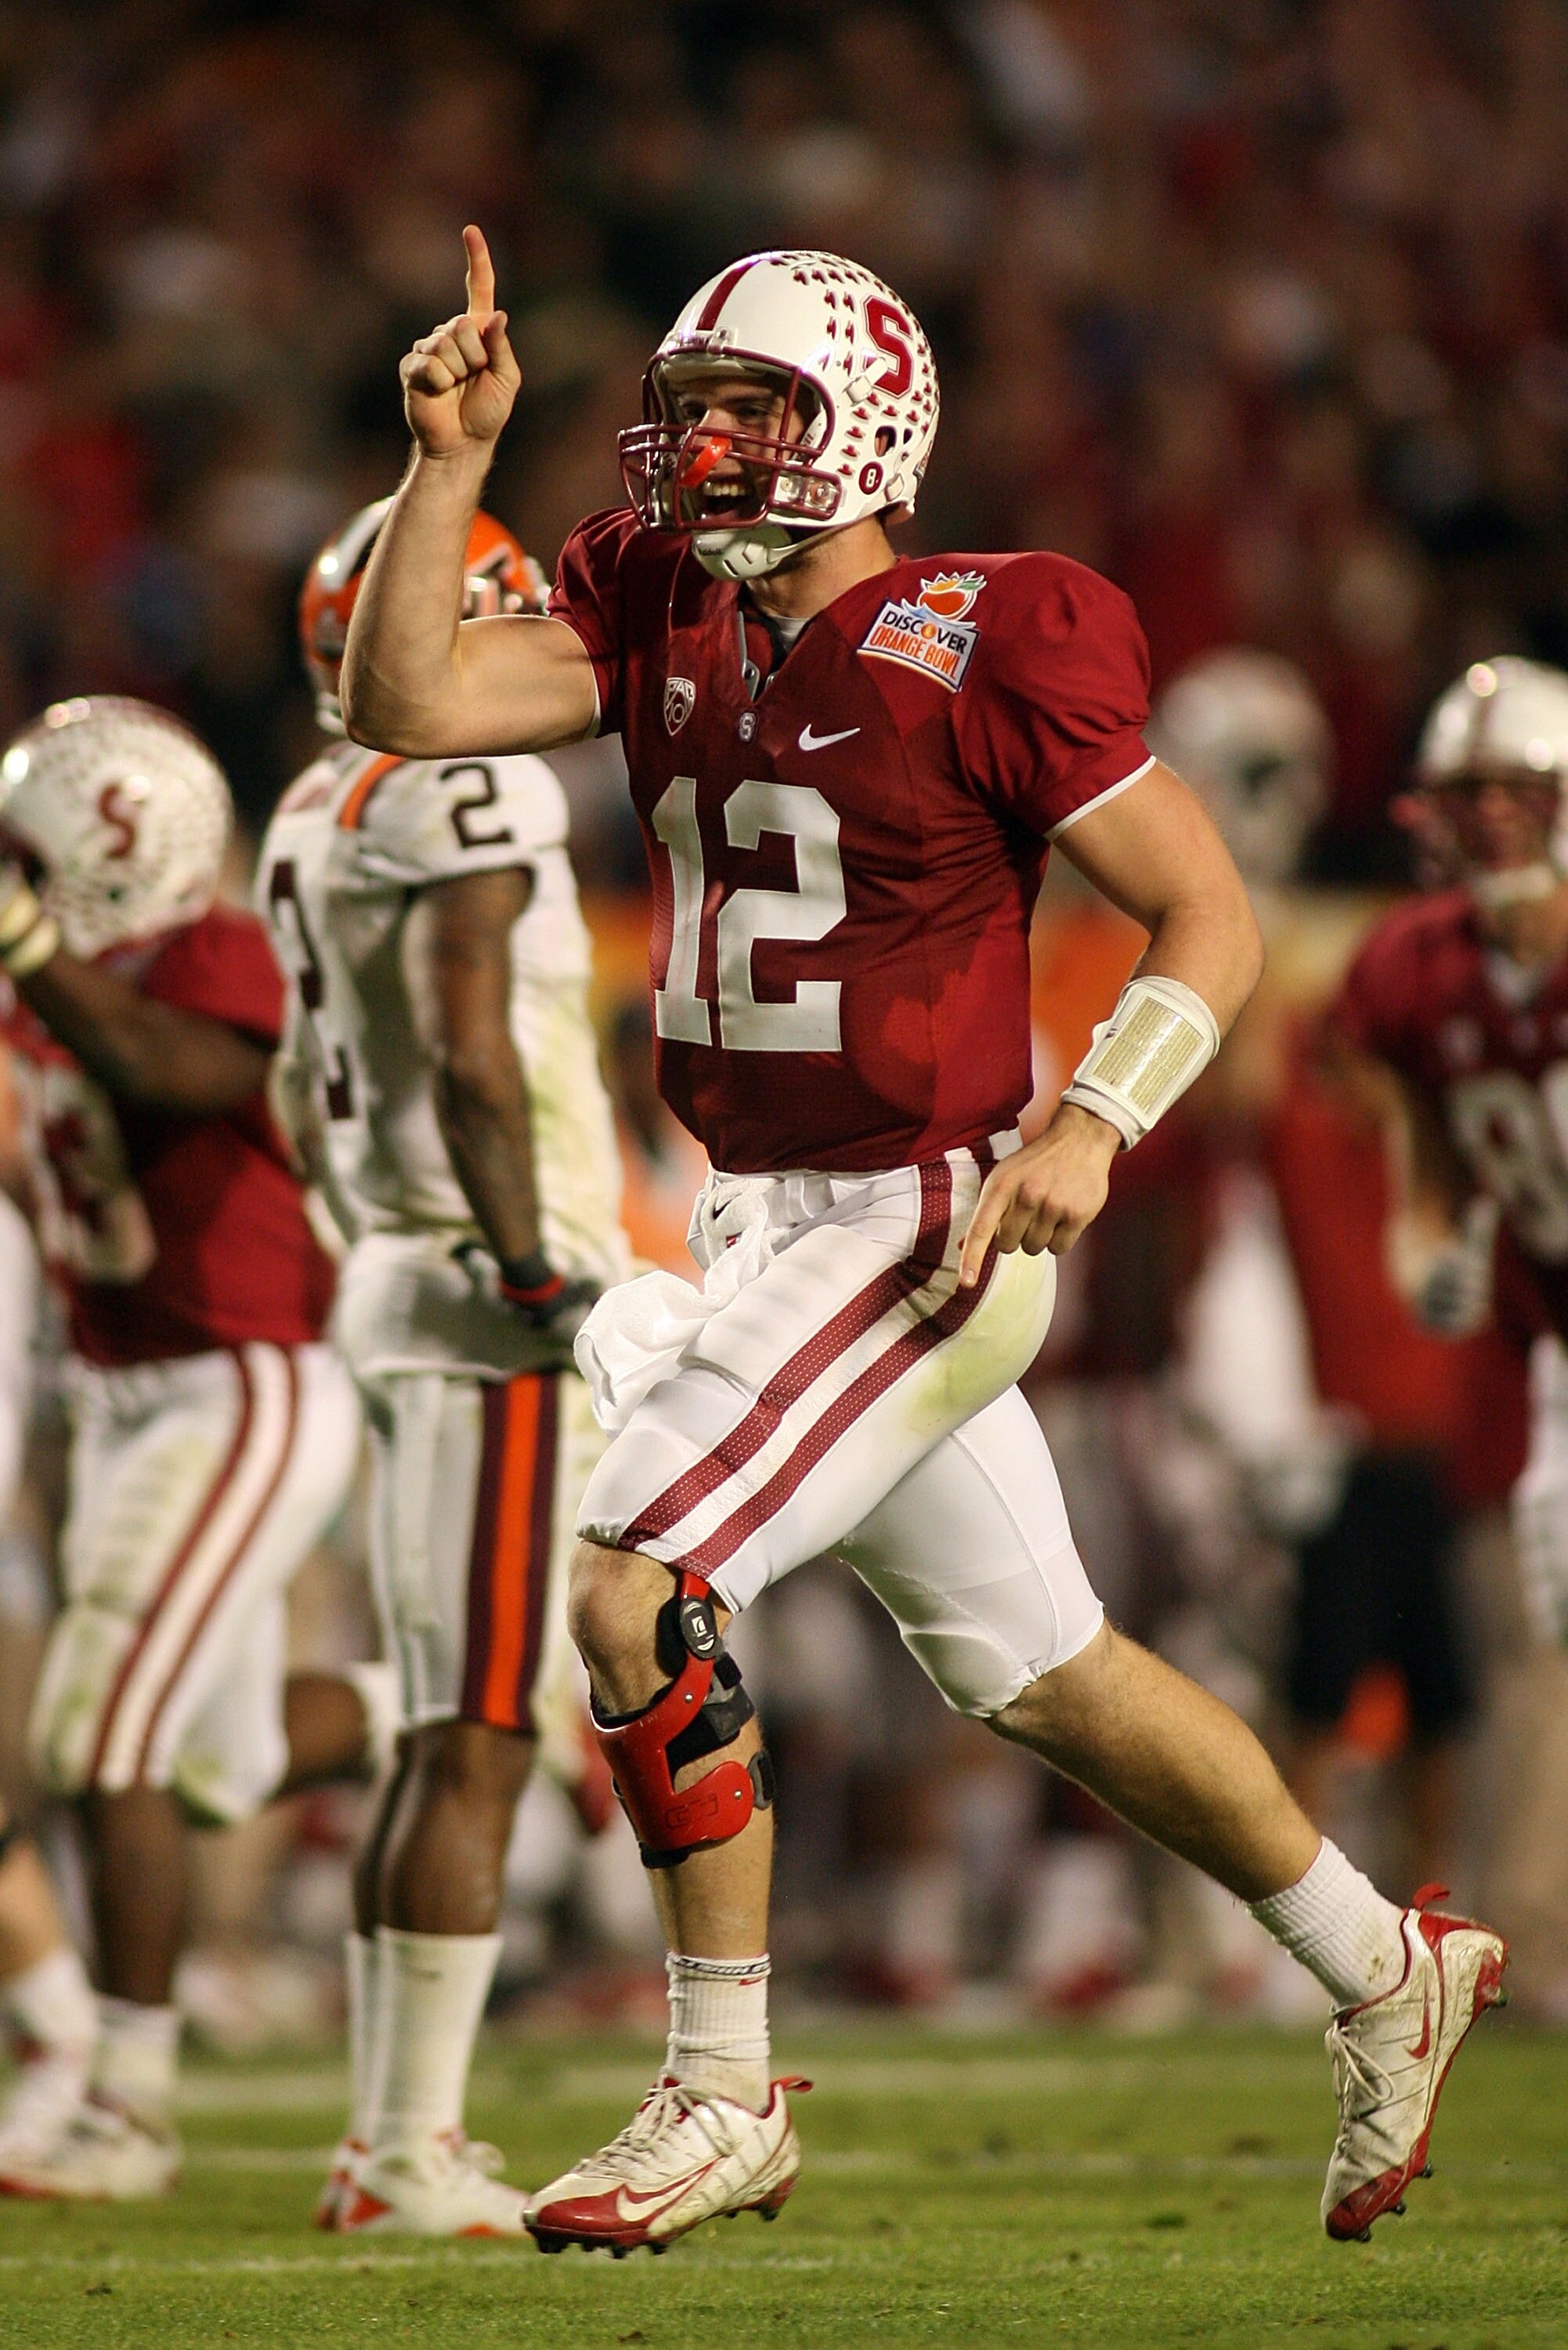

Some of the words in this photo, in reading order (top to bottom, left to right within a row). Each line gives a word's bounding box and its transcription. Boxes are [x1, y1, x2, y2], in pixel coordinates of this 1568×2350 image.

[864, 295, 913, 400] S
[869, 624, 927, 660] ORANGE
[923, 644, 961, 680] BOWL
[882, 609, 969, 655] DISCOVER
[440, 761, 514, 849] 2
[652, 776, 847, 1052] 12
